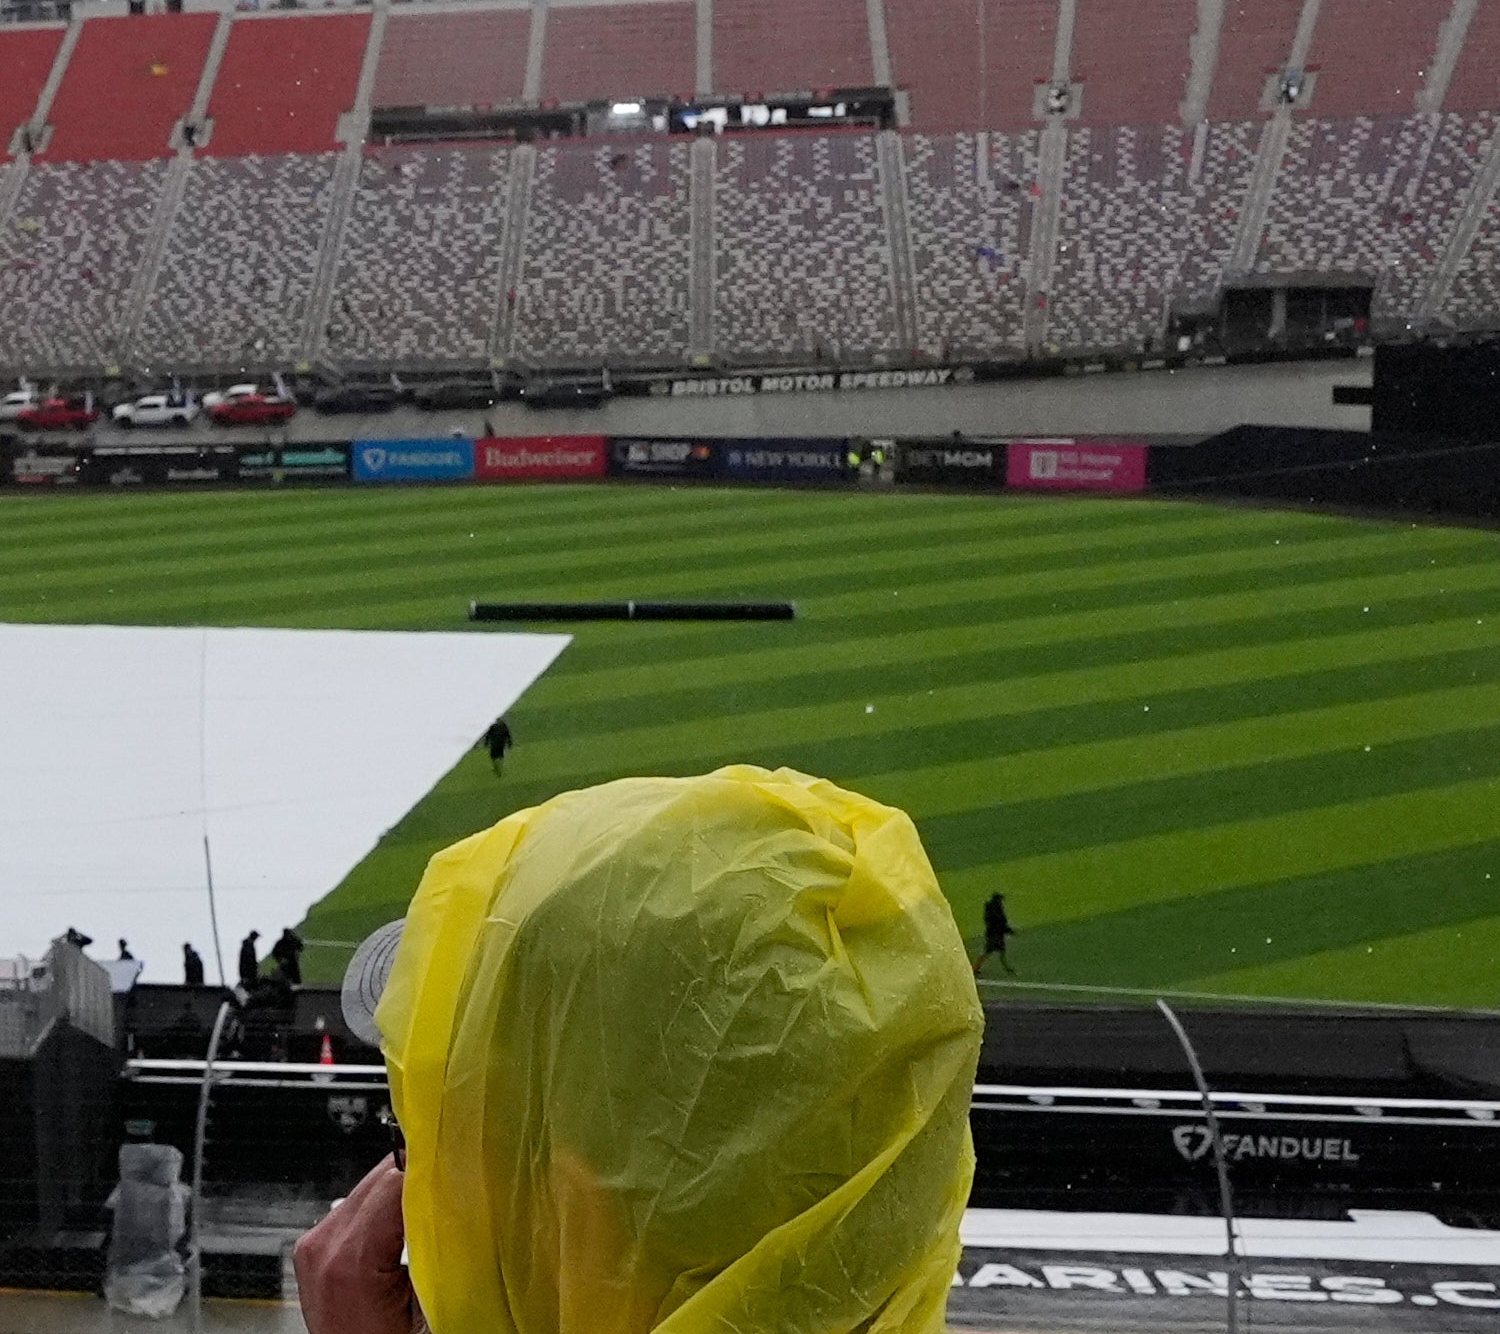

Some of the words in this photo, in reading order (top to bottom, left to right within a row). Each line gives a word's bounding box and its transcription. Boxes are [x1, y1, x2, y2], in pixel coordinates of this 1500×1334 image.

[671, 376, 757, 397] BRISTOL
[760, 373, 834, 394] MOTOR
[839, 369, 951, 390] SPEEDWAY
[485, 446, 596, 468] Budweiser
[1222, 1133, 1361, 1161] FANDUEL
